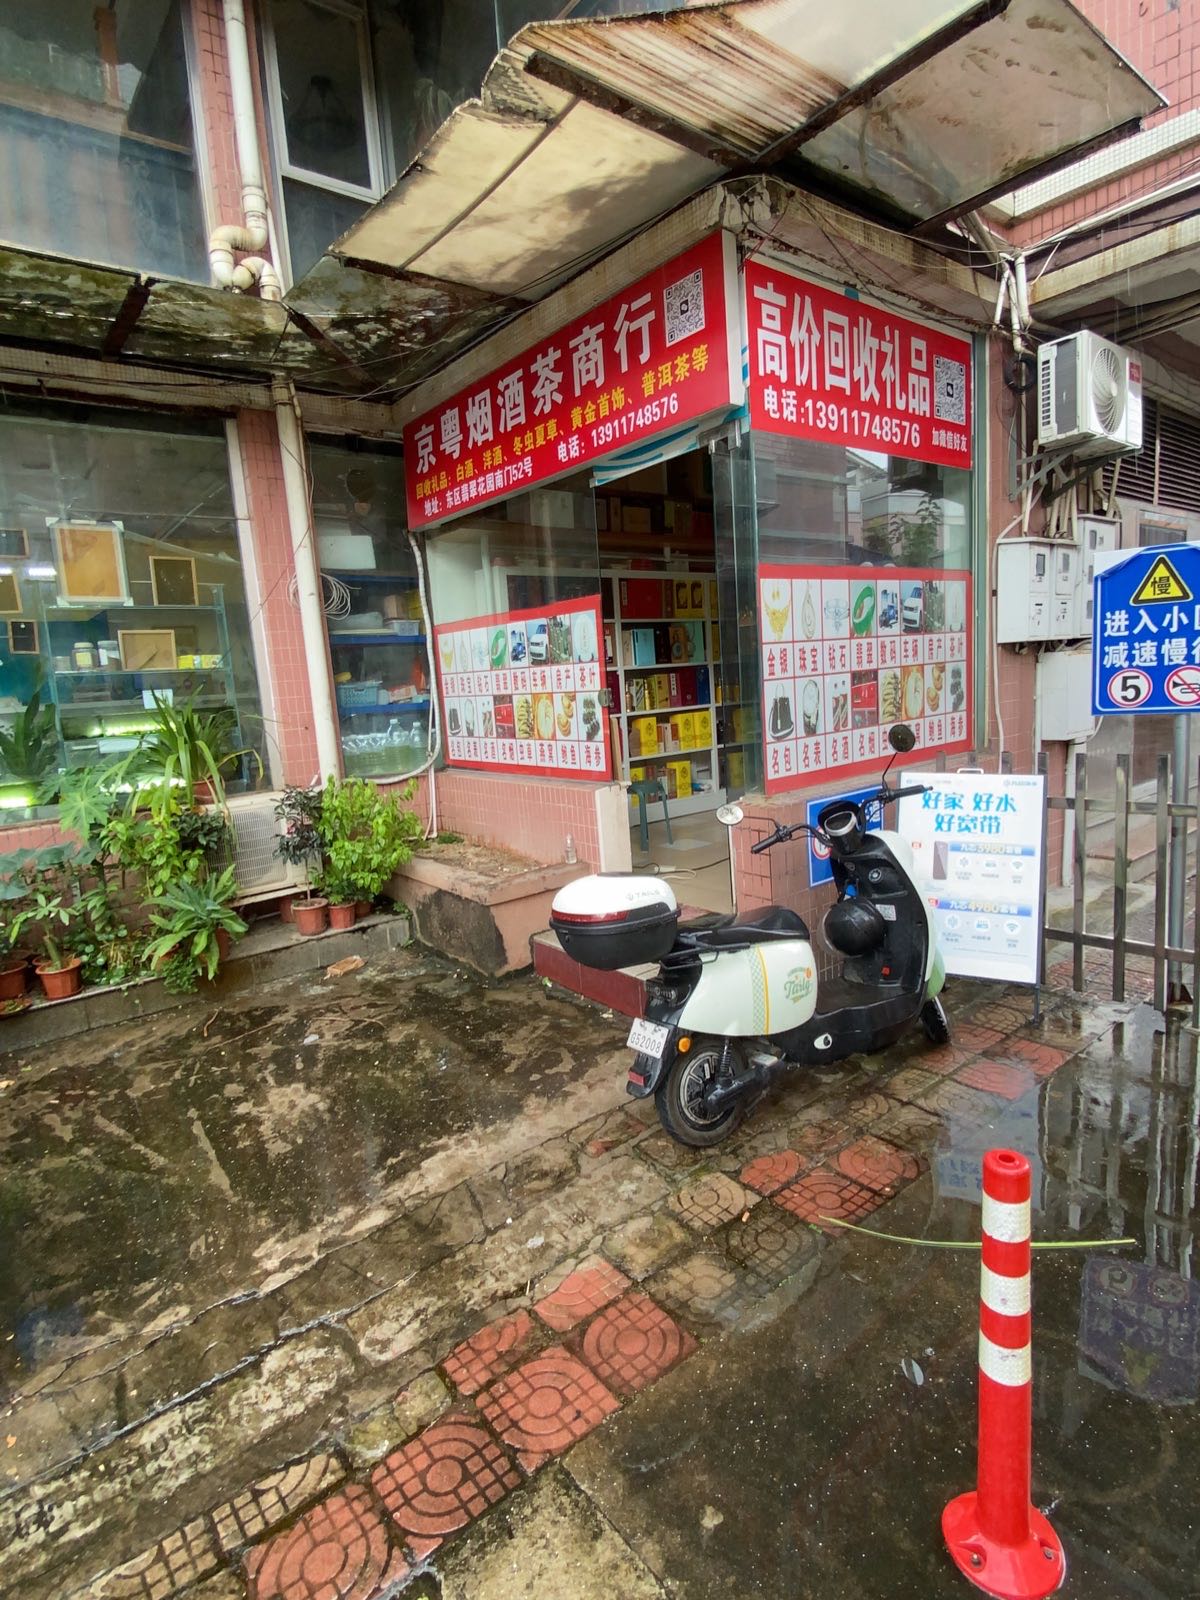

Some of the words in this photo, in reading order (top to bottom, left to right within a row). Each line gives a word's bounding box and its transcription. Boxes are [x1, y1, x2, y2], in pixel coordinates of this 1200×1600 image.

[753, 282, 931, 418] 高价回收礼品
[414, 292, 656, 475] 京粤烟酒茶商行
[1151, 576, 1171, 595] 慢
[1121, 675, 1141, 702] 5
[922, 791, 964, 810] 好家
[973, 792, 1016, 812] 好水
[934, 813, 1001, 834] 好宽带
